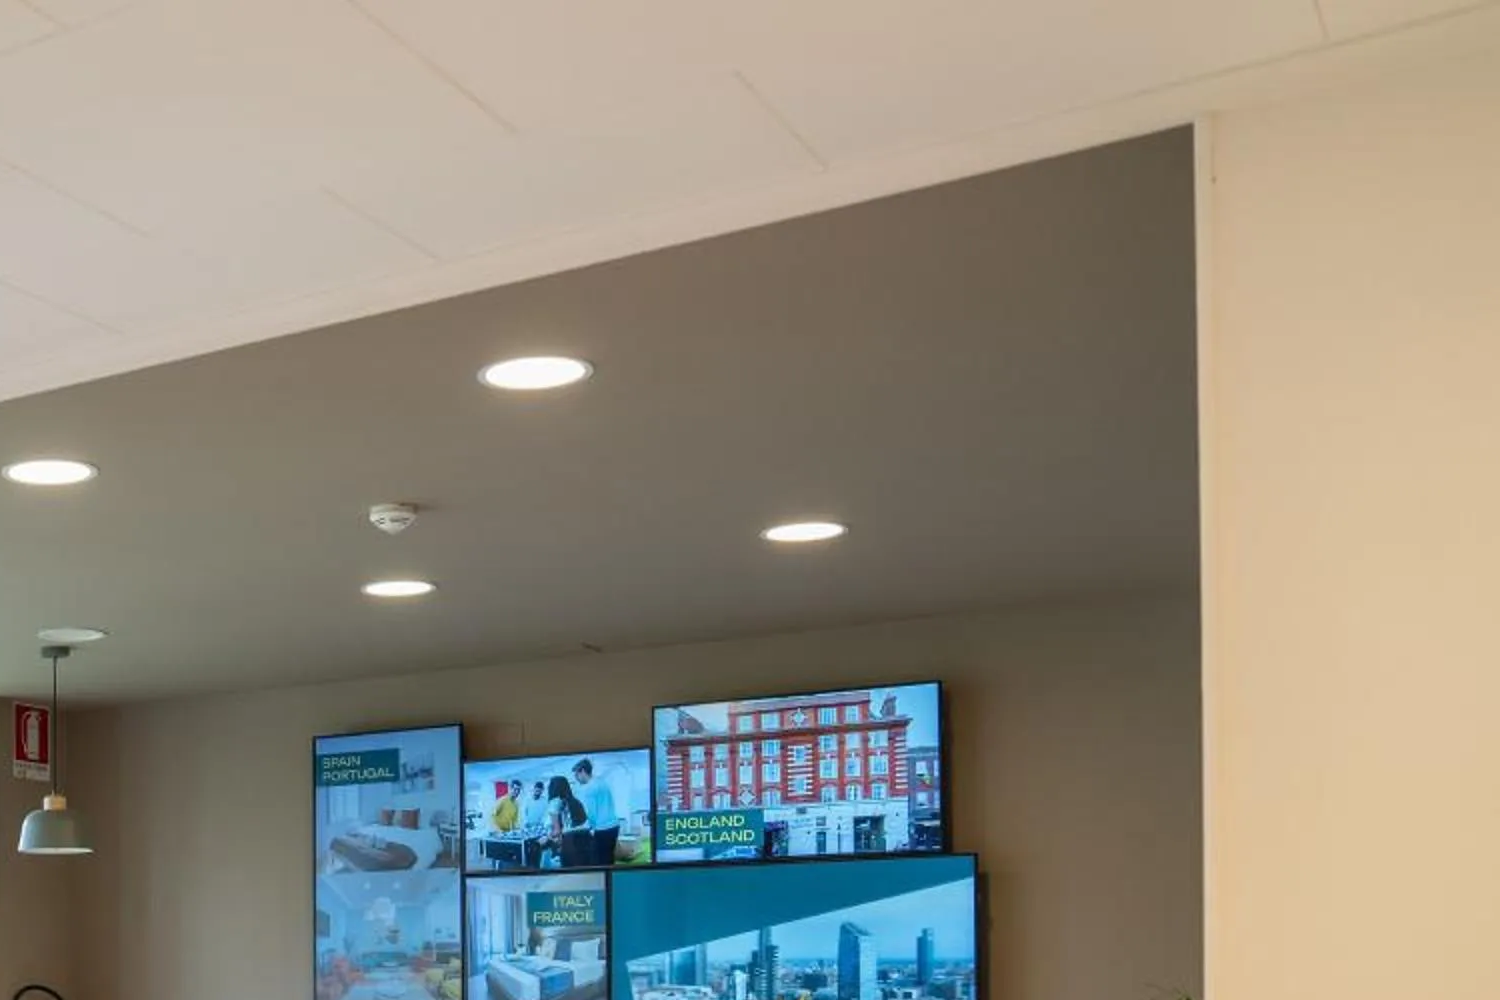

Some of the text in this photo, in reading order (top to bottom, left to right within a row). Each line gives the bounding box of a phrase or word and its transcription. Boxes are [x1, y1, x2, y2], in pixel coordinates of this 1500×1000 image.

[323, 756, 361, 769] SPAIN
[323, 767, 396, 781] PORTUGAL
[665, 815, 745, 831] ENGLAND
[665, 829, 755, 845] SCOTLAND
[553, 895, 593, 908] ITALY
[533, 909, 594, 924] FRANCE
